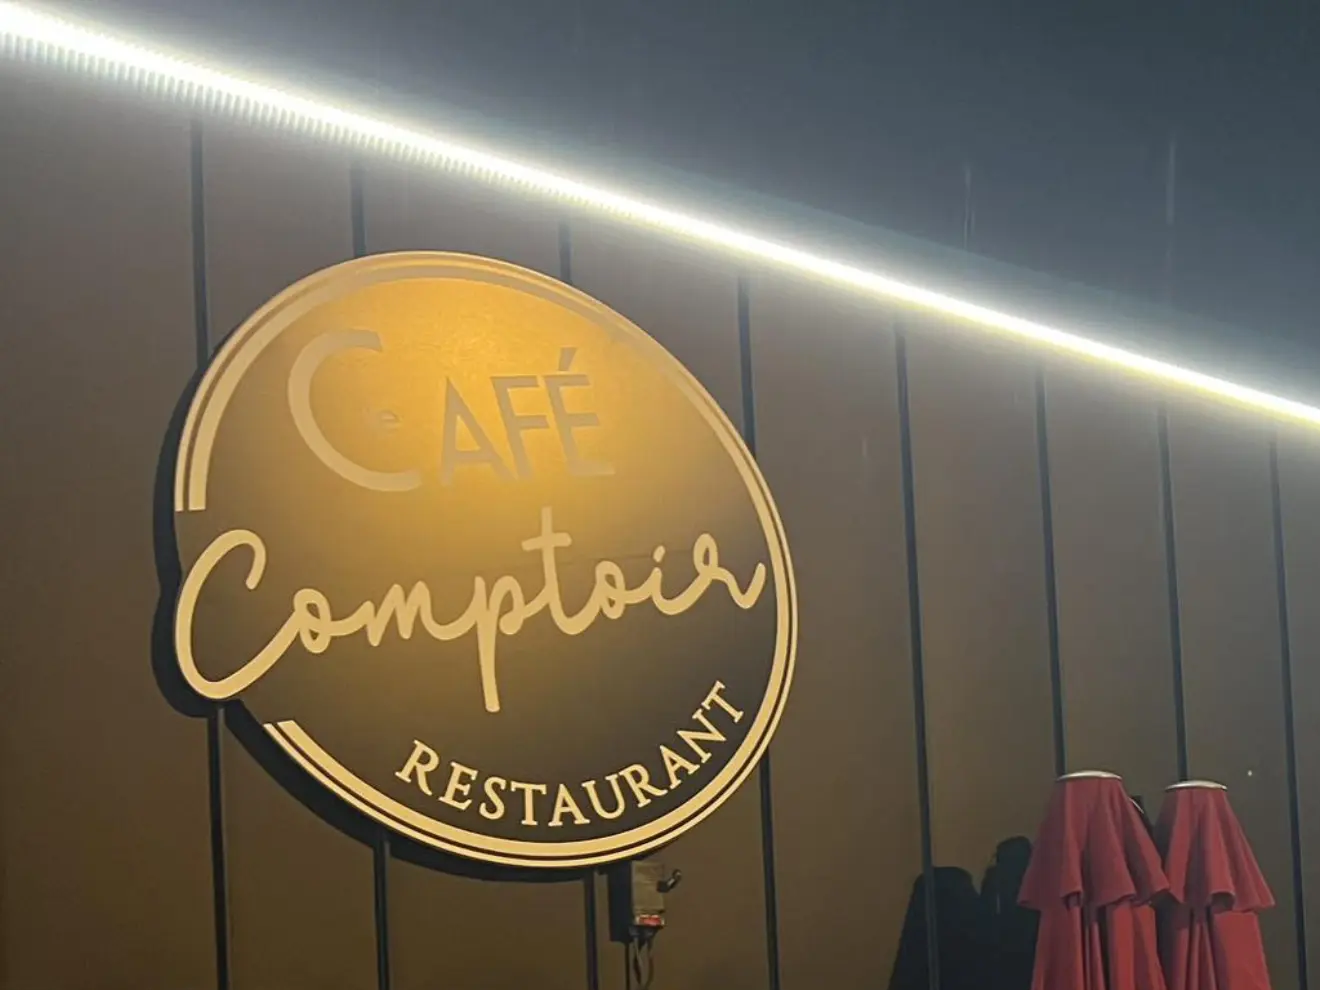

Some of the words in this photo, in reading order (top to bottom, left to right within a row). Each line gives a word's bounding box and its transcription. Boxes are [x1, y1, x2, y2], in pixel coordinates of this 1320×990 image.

[286, 327, 617, 493] CAFÉ
[174, 505, 766, 713] Comptoir
[394, 680, 746, 828] RESTAURANT
